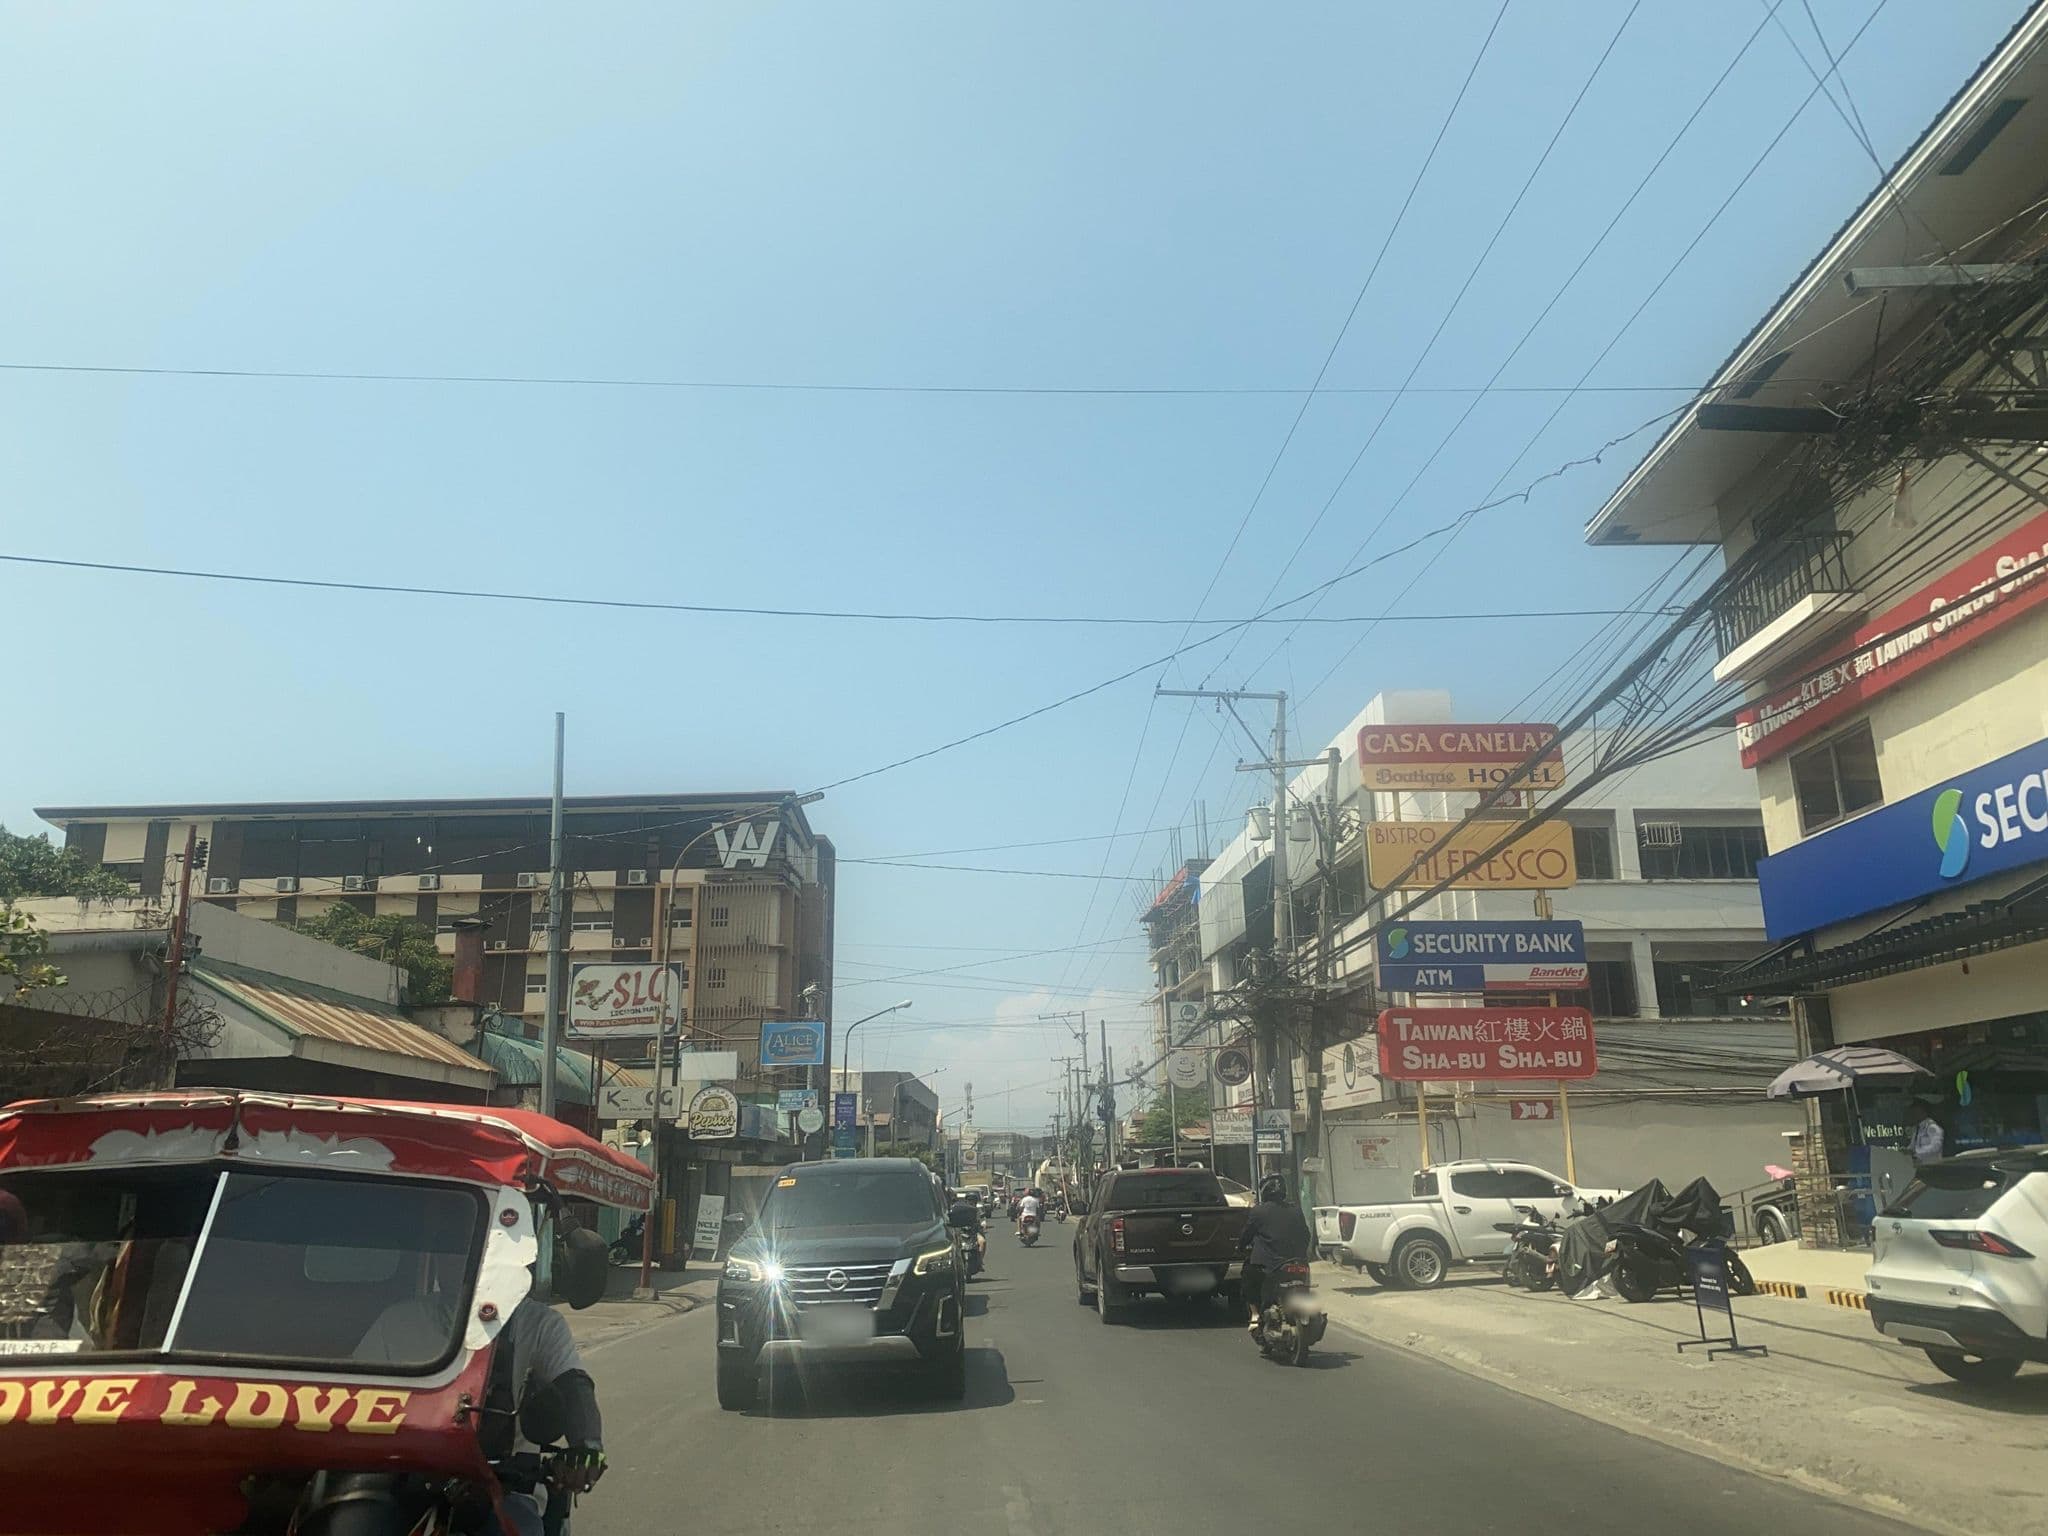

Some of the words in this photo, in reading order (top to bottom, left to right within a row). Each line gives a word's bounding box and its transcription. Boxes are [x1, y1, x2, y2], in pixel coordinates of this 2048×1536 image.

[1996, 542, 2048, 594] SHA
[1364, 733, 1434, 753] CASA
[1468, 767, 1557, 783] HOEL
[1975, 769, 2048, 849] SEC
[1375, 827, 1436, 844] BISTRO
[1414, 933, 1510, 954] SECURITY
[1515, 932, 1575, 953] BANK
[1415, 969, 1453, 985] ATM
[1530, 966, 1585, 977] BancNet
[1393, 1018, 1474, 1041] TAIWAN
[1474, 1017, 1588, 1043] 紅樓火鍋
[772, 1034, 813, 1048] ALICE
[1403, 1046, 1486, 1069] SHA-BU
[1499, 1044, 1582, 1068] SHA-BU
[160, 1379, 415, 1435] LOVE
